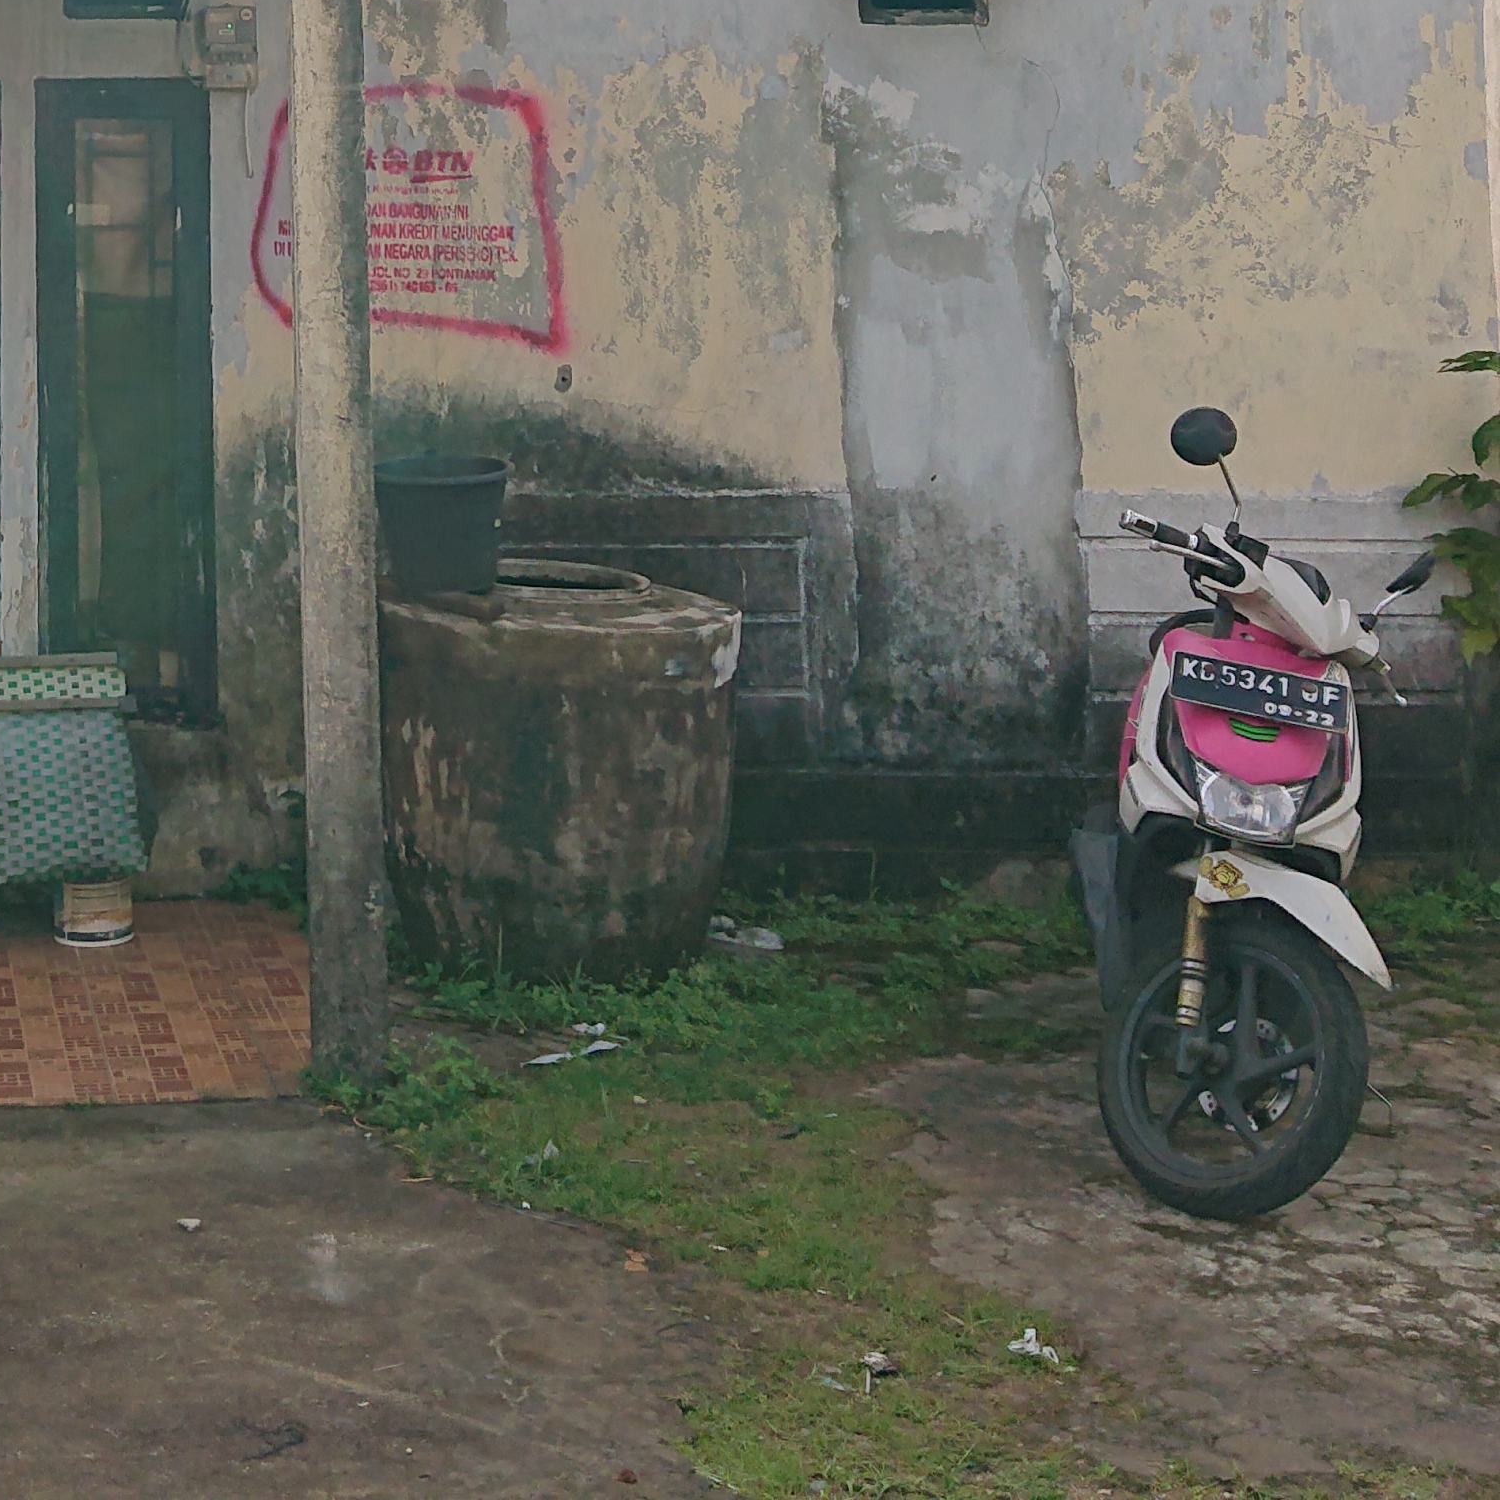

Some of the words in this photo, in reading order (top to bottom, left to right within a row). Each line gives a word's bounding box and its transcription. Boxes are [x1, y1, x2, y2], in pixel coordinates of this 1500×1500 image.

[413, 150, 474, 172] BTN
[389, 202, 454, 220] BANGUNAN
[400, 224, 439, 240] KREDIT
[442, 225, 514, 241] MENUNGGAK
[384, 244, 430, 260] NEGARA
[432, 268, 497, 282] PONTIANAK
[1221, 665, 1288, 697] 5341
